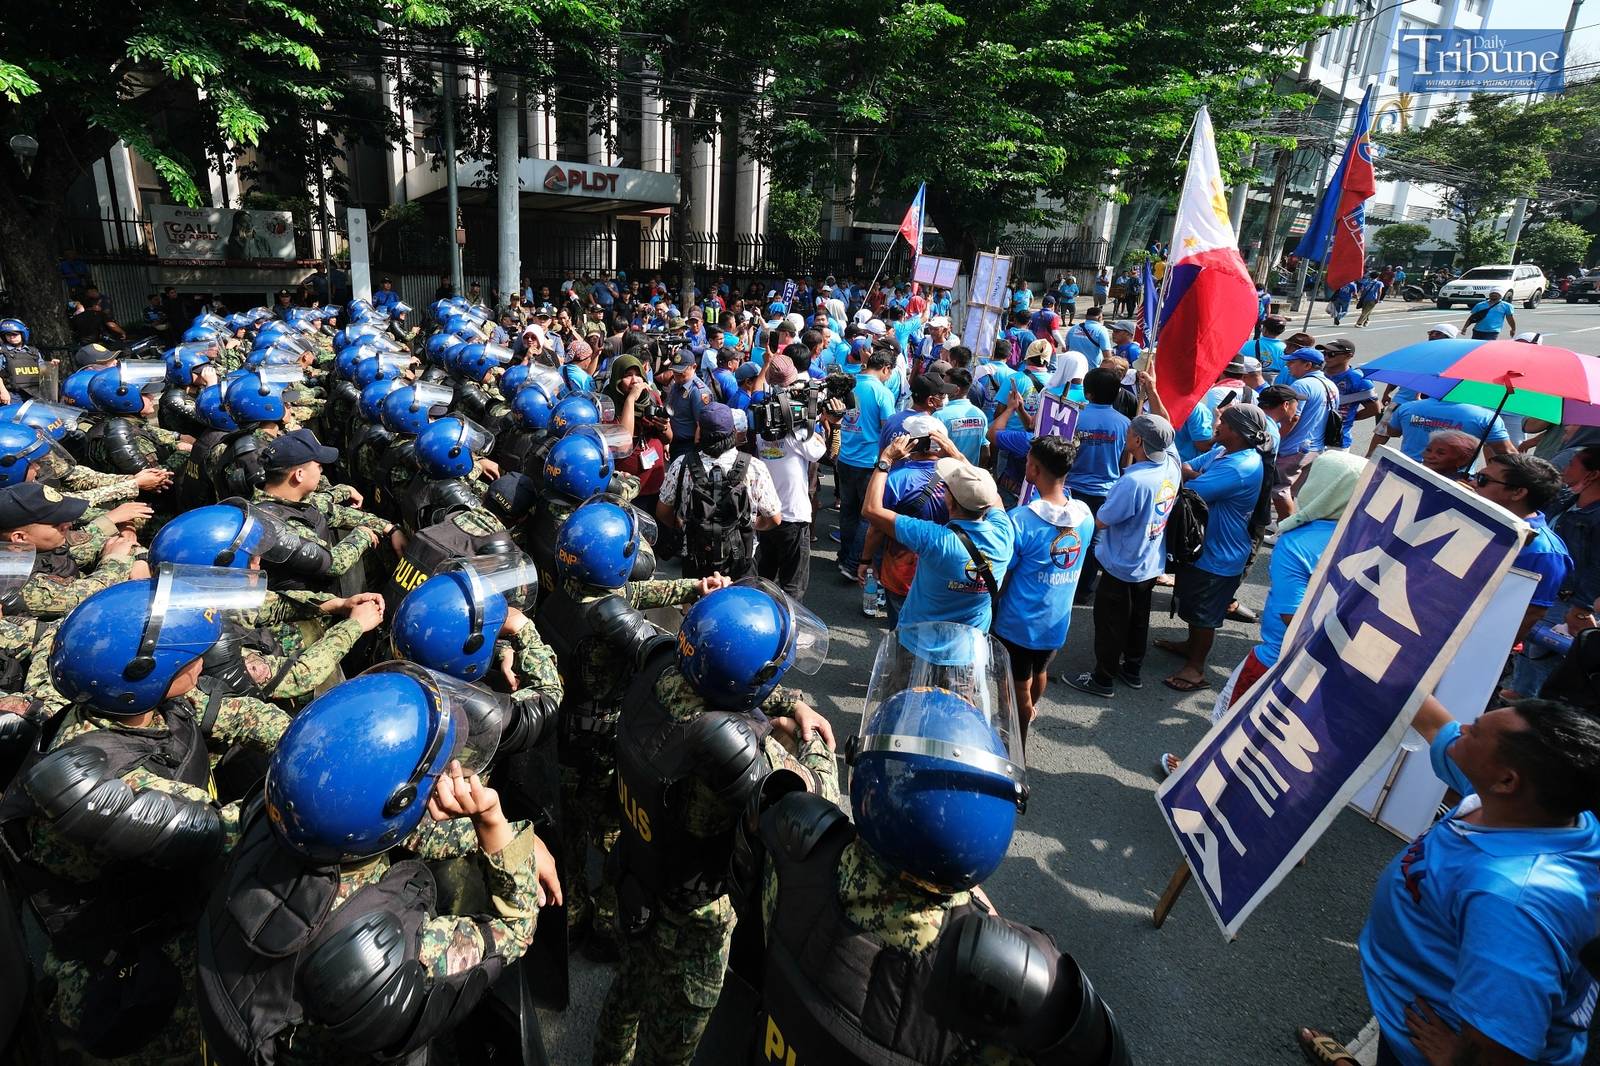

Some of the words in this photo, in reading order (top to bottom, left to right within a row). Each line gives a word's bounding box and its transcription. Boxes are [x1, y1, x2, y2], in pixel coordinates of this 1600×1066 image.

[568, 169, 619, 193] PLDT
[169, 223, 218, 234] CALL
[173, 233, 186, 241] TO
[190, 233, 220, 241] APPLY
[15, 366, 40, 375] PULIS
[553, 415, 567, 427] PNP
[546, 464, 561, 477] PNP
[558, 548, 578, 565] PNP
[678, 630, 695, 658] PNP
[617, 775, 652, 843] ULIS
